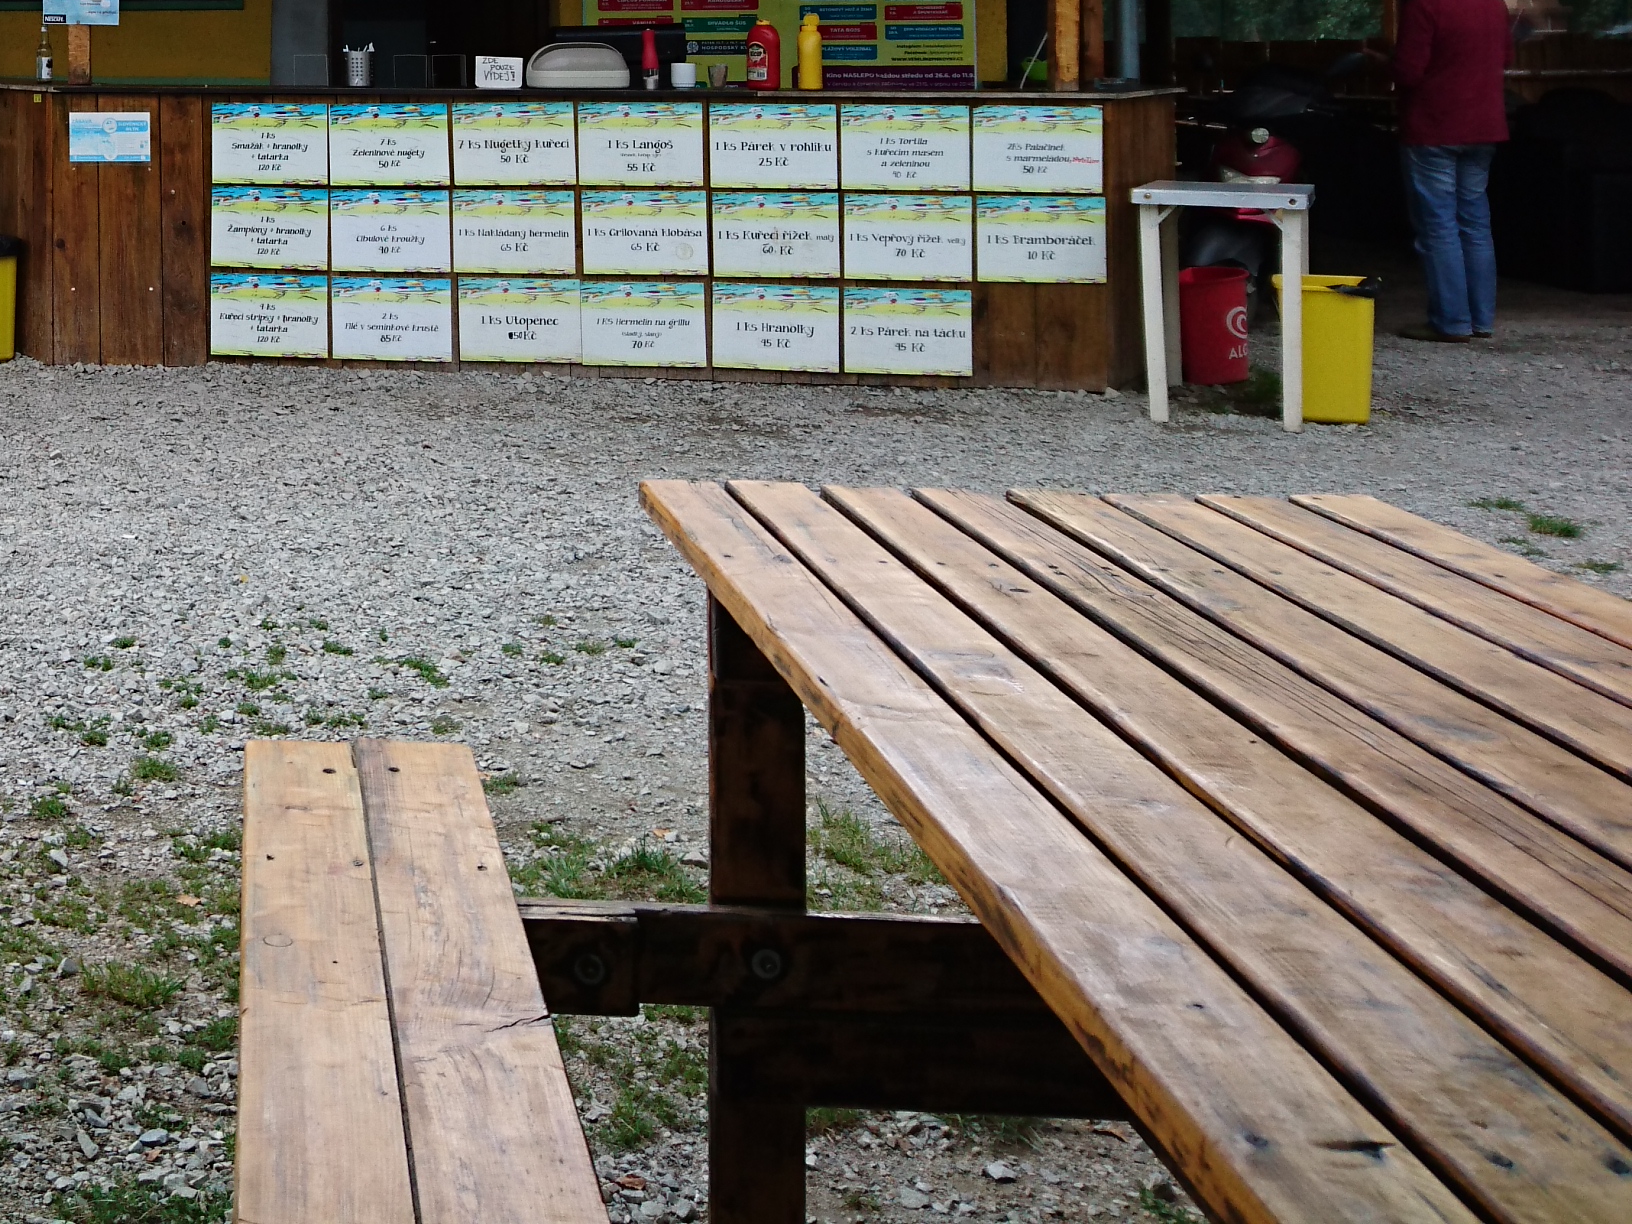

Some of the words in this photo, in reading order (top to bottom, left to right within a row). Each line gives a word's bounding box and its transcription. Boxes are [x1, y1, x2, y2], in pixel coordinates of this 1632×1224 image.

[231, 142, 264, 150] Smažák
[273, 142, 308, 153] hranolky
[458, 140, 464, 149] 7
[468, 140, 481, 149] ks
[484, 139, 531, 153] Nugetky
[615, 140, 629, 149] ks
[633, 139, 673, 154] Langoš
[723, 142, 737, 150] ks
[741, 141, 774, 151] Párek
[790, 142, 832, 152] rohlíku
[1025, 143, 1065, 151] Palačinek
[257, 153, 289, 161] tatarka
[398, 149, 425, 160] nugety
[500, 155, 511, 163] 50
[515, 154, 529, 164] Kč
[379, 160, 389, 169] 50
[758, 157, 773, 166] 25
[775, 157, 789, 166] Kč
[627, 164, 638, 172] 55
[642, 162, 656, 172] Kč
[1023, 165, 1034, 174] 50
[227, 224, 268, 236] Žampiony
[275, 227, 312, 238] hranolky
[478, 228, 526, 240] Nakládaný
[594, 228, 606, 237] ks
[609, 228, 658, 237] Grilovaná
[661, 228, 702, 238] klobása
[726, 231, 739, 240] ks
[743, 230, 779, 240] Kuřecí
[782, 230, 812, 240] řízek
[256, 237, 288, 245] tatarka
[391, 235, 425, 245] kroužky
[857, 233, 868, 241] ks
[871, 233, 914, 247] Vepřový
[917, 234, 943, 243] řízek
[995, 235, 1009, 244] ks
[1013, 235, 1096, 246] Bramboráček
[500, 244, 512, 252] 65
[515, 243, 529, 252] Kč
[631, 243, 642, 251] 65
[646, 242, 660, 252] Kč
[780, 246, 794, 255] Kč
[895, 248, 907, 257] 70
[911, 248, 925, 258] Kč
[1028, 251, 1037, 260] 10
[1041, 250, 1055, 260] Kč
[245, 314, 274, 325] stripsy
[283, 315, 318, 325] hranolky
[488, 315, 502, 325] ks
[505, 316, 559, 330] Utopenec
[668, 318, 690, 329] grillu
[256, 325, 288, 333] tatarka
[744, 322, 758, 331] ks
[761, 323, 815, 337] Hranolky
[850, 326, 857, 335] 2
[861, 326, 874, 336] ks
[877, 326, 910, 336] Párek
[915, 329, 929, 337] na
[934, 328, 966, 338] tácku
[524, 331, 537, 340] Kč
[632, 341, 642, 349] 70
[777, 338, 791, 348] Kč
[912, 342, 925, 352] Kč
